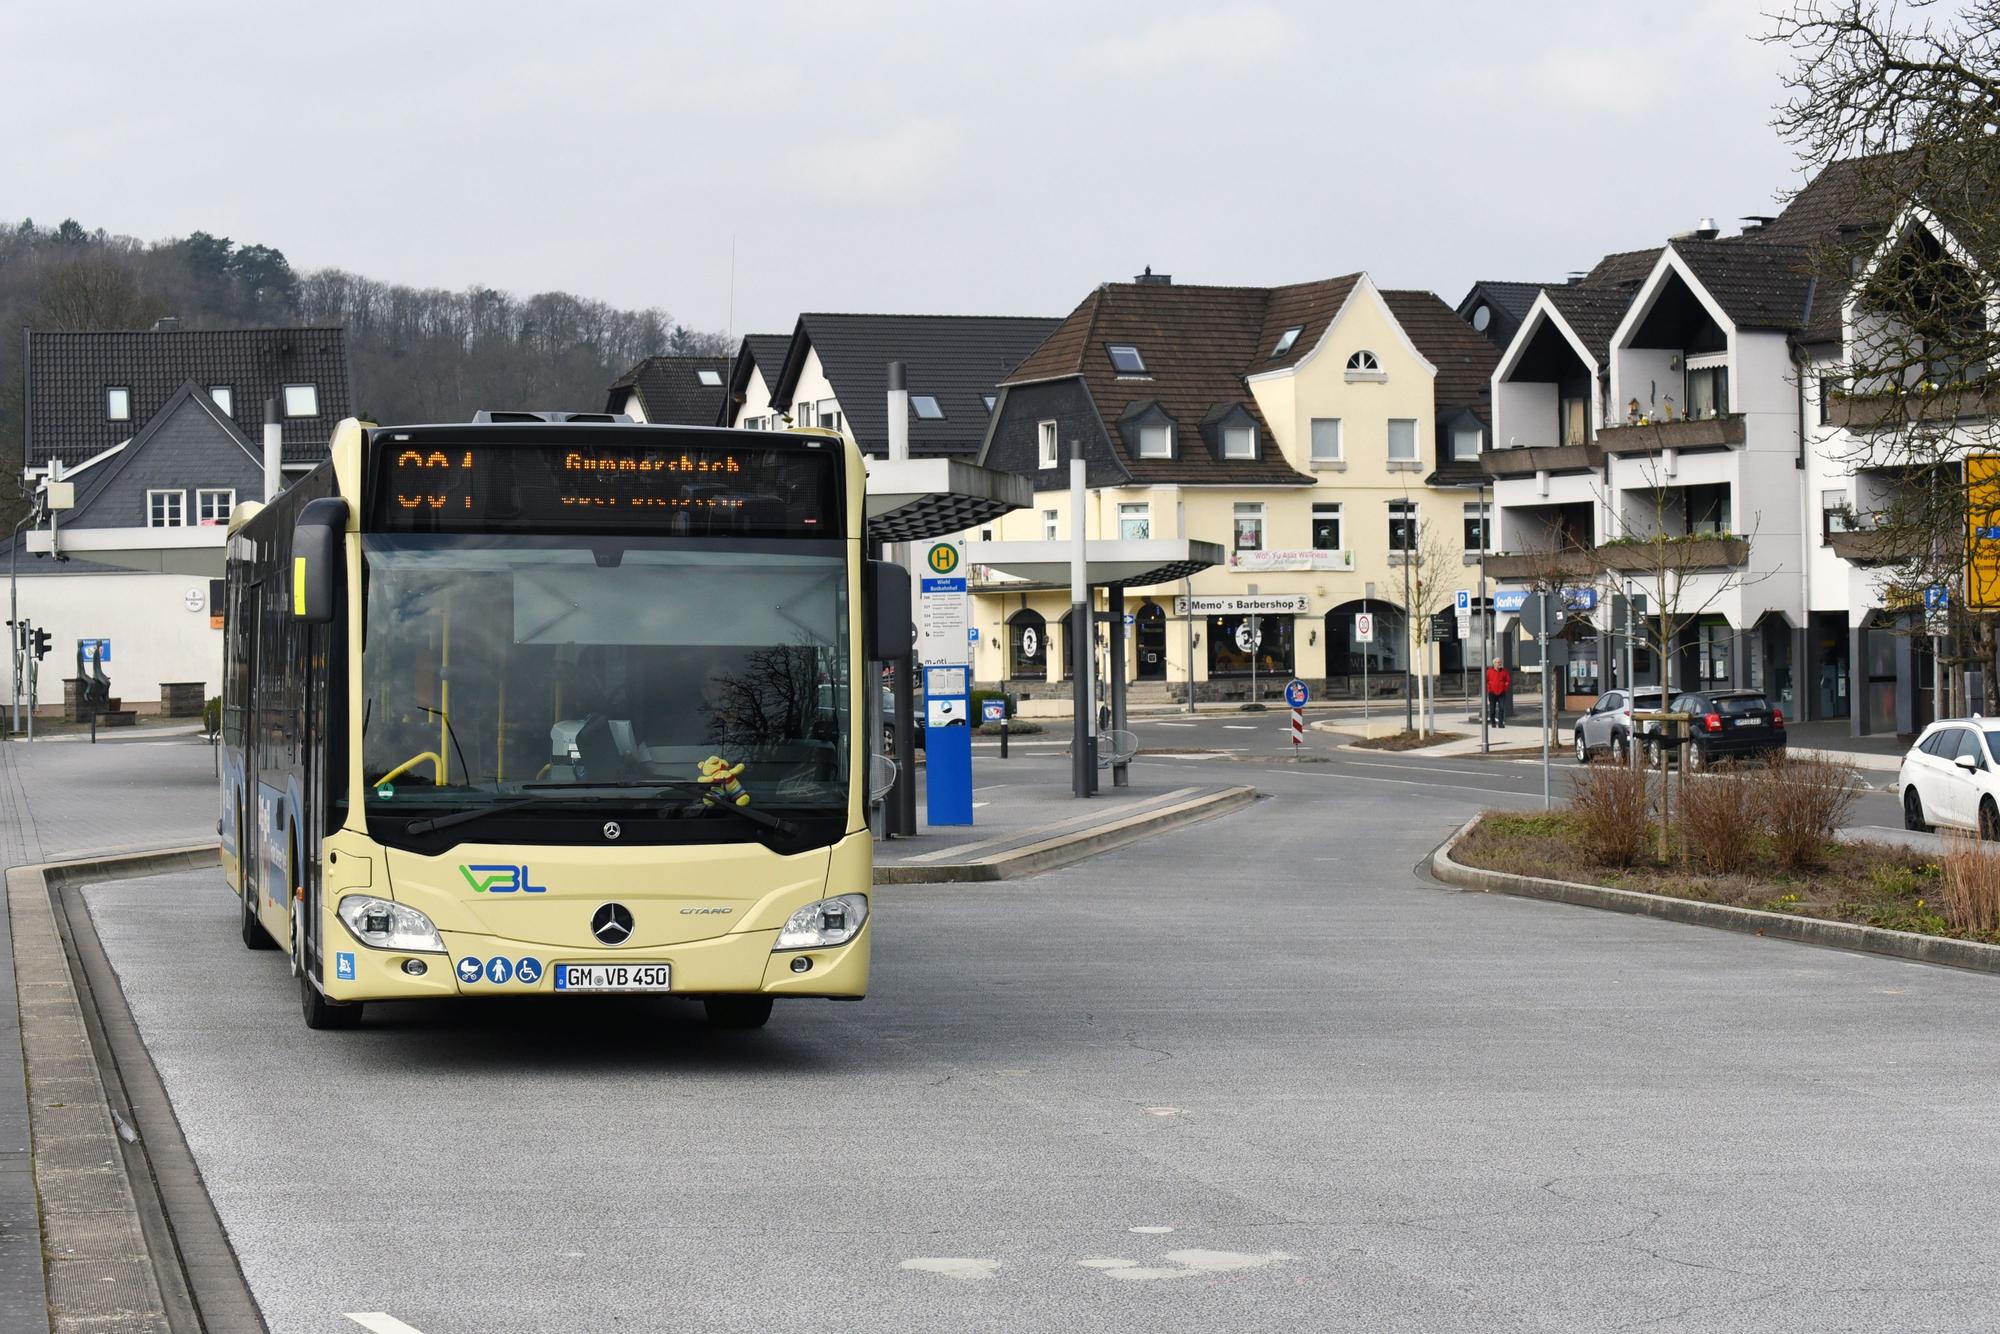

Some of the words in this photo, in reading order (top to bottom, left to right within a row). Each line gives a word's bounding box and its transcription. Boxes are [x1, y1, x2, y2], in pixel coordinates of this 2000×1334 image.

[936, 549, 950, 567] H
[1236, 600, 1294, 610] Barbershop
[1459, 594, 1466, 607] P
[969, 629, 977, 640] P
[458, 864, 547, 893] VBL
[679, 907, 733, 915] CITARO
[568, 968, 592, 985] GM
[605, 968, 628, 985] VB
[632, 968, 667, 985] 450
